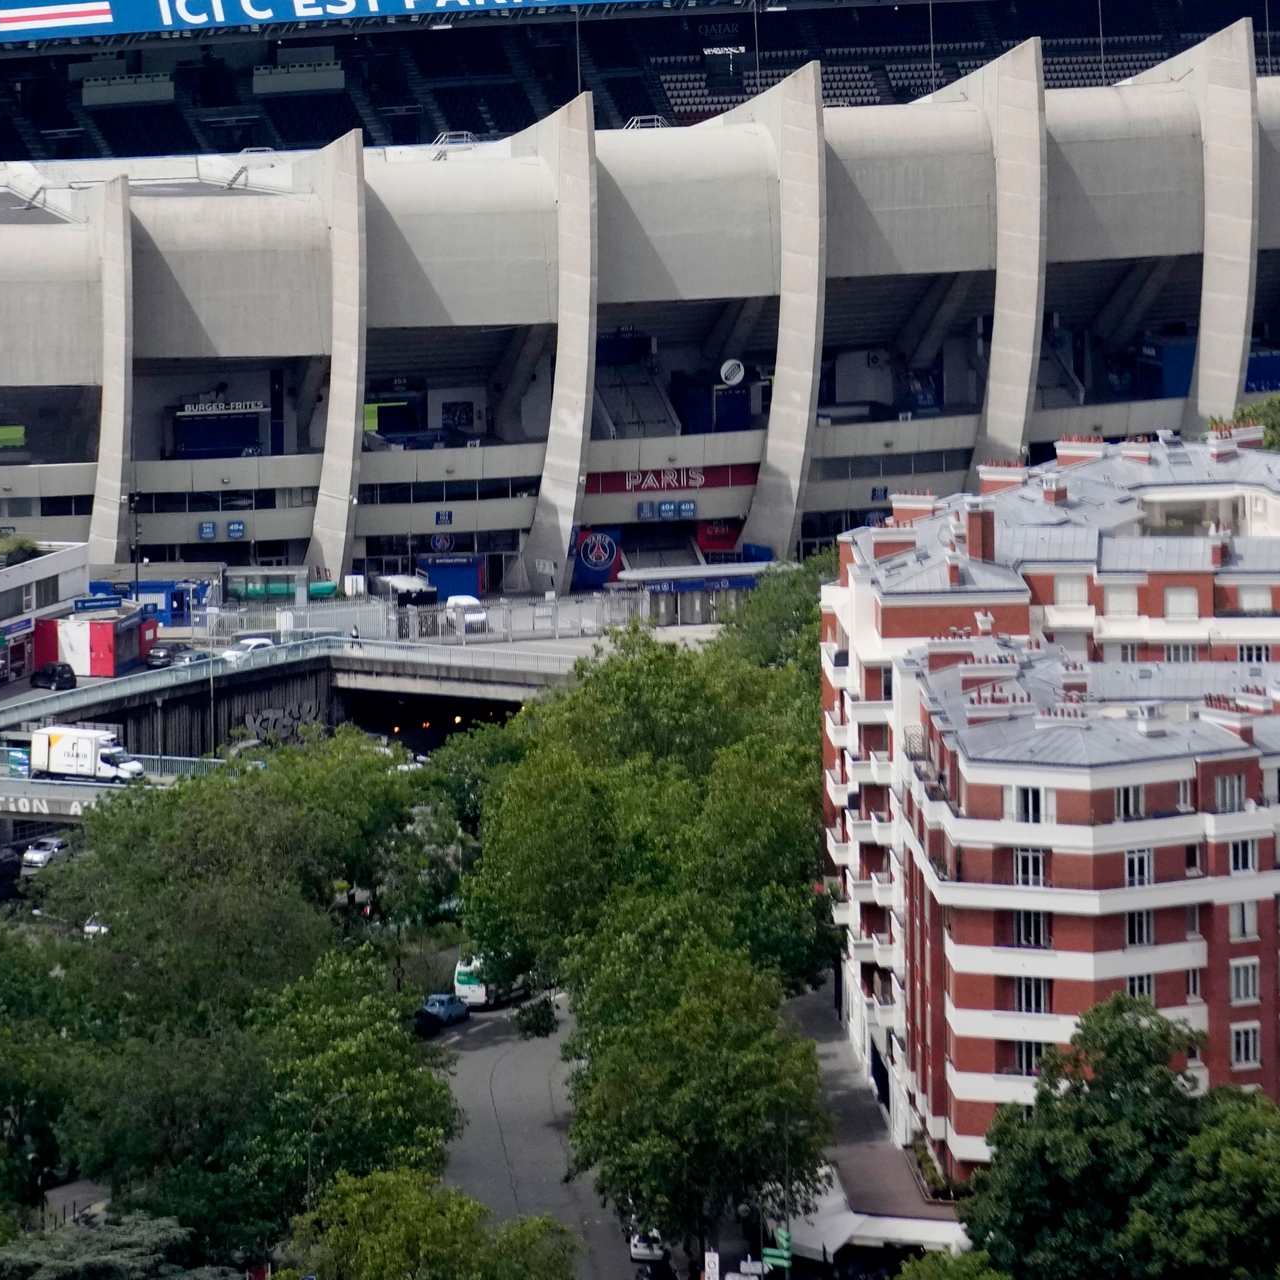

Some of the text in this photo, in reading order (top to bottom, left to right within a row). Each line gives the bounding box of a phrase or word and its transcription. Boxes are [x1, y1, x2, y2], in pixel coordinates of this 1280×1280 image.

[698, 23, 739, 36] QATAR
[184, 401, 263, 412] BURGER-FRITES
[626, 467, 705, 491] PARIS
[587, 535, 609, 545] PARIS
[64, 751, 88, 759] FRAKIN
